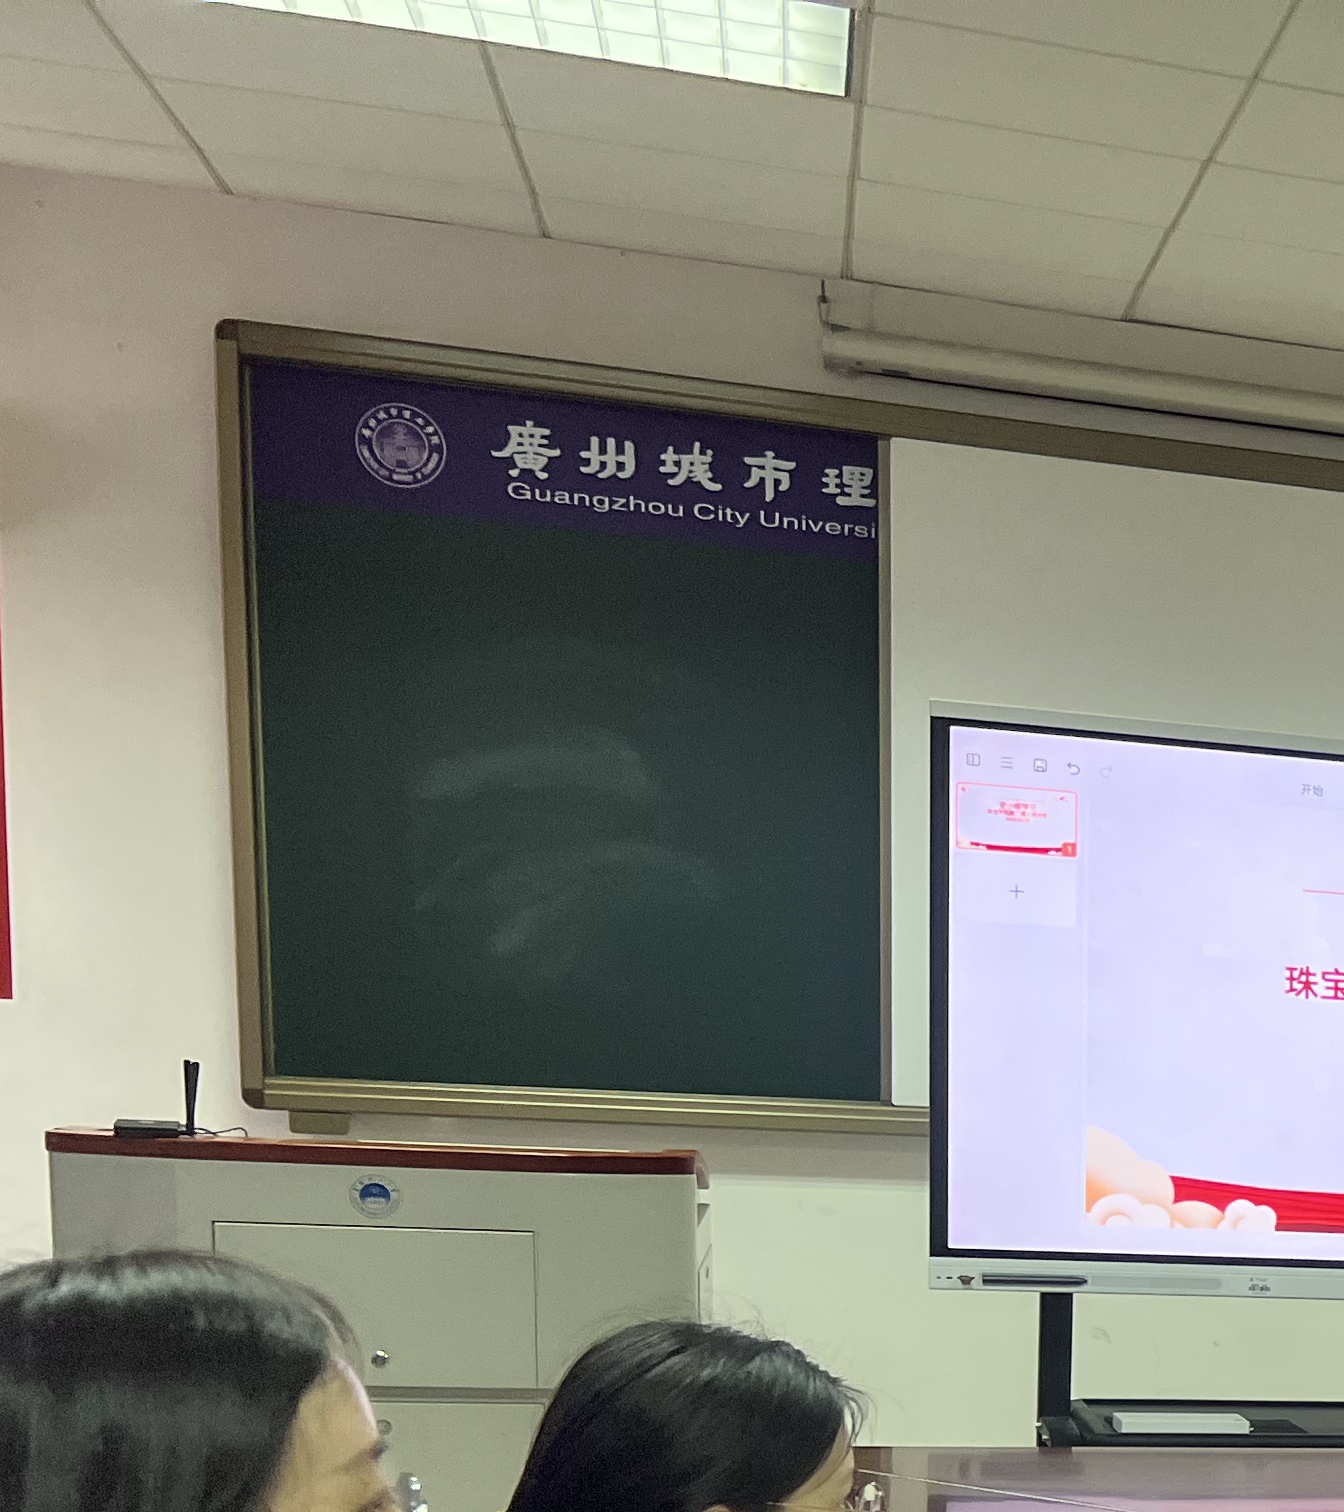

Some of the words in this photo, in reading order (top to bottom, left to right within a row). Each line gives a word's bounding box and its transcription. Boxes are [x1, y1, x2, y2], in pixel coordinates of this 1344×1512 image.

[506, 481, 684, 517] Guangzhou
[692, 502, 751, 528] City
[1301, 783, 1324, 797] 开始
